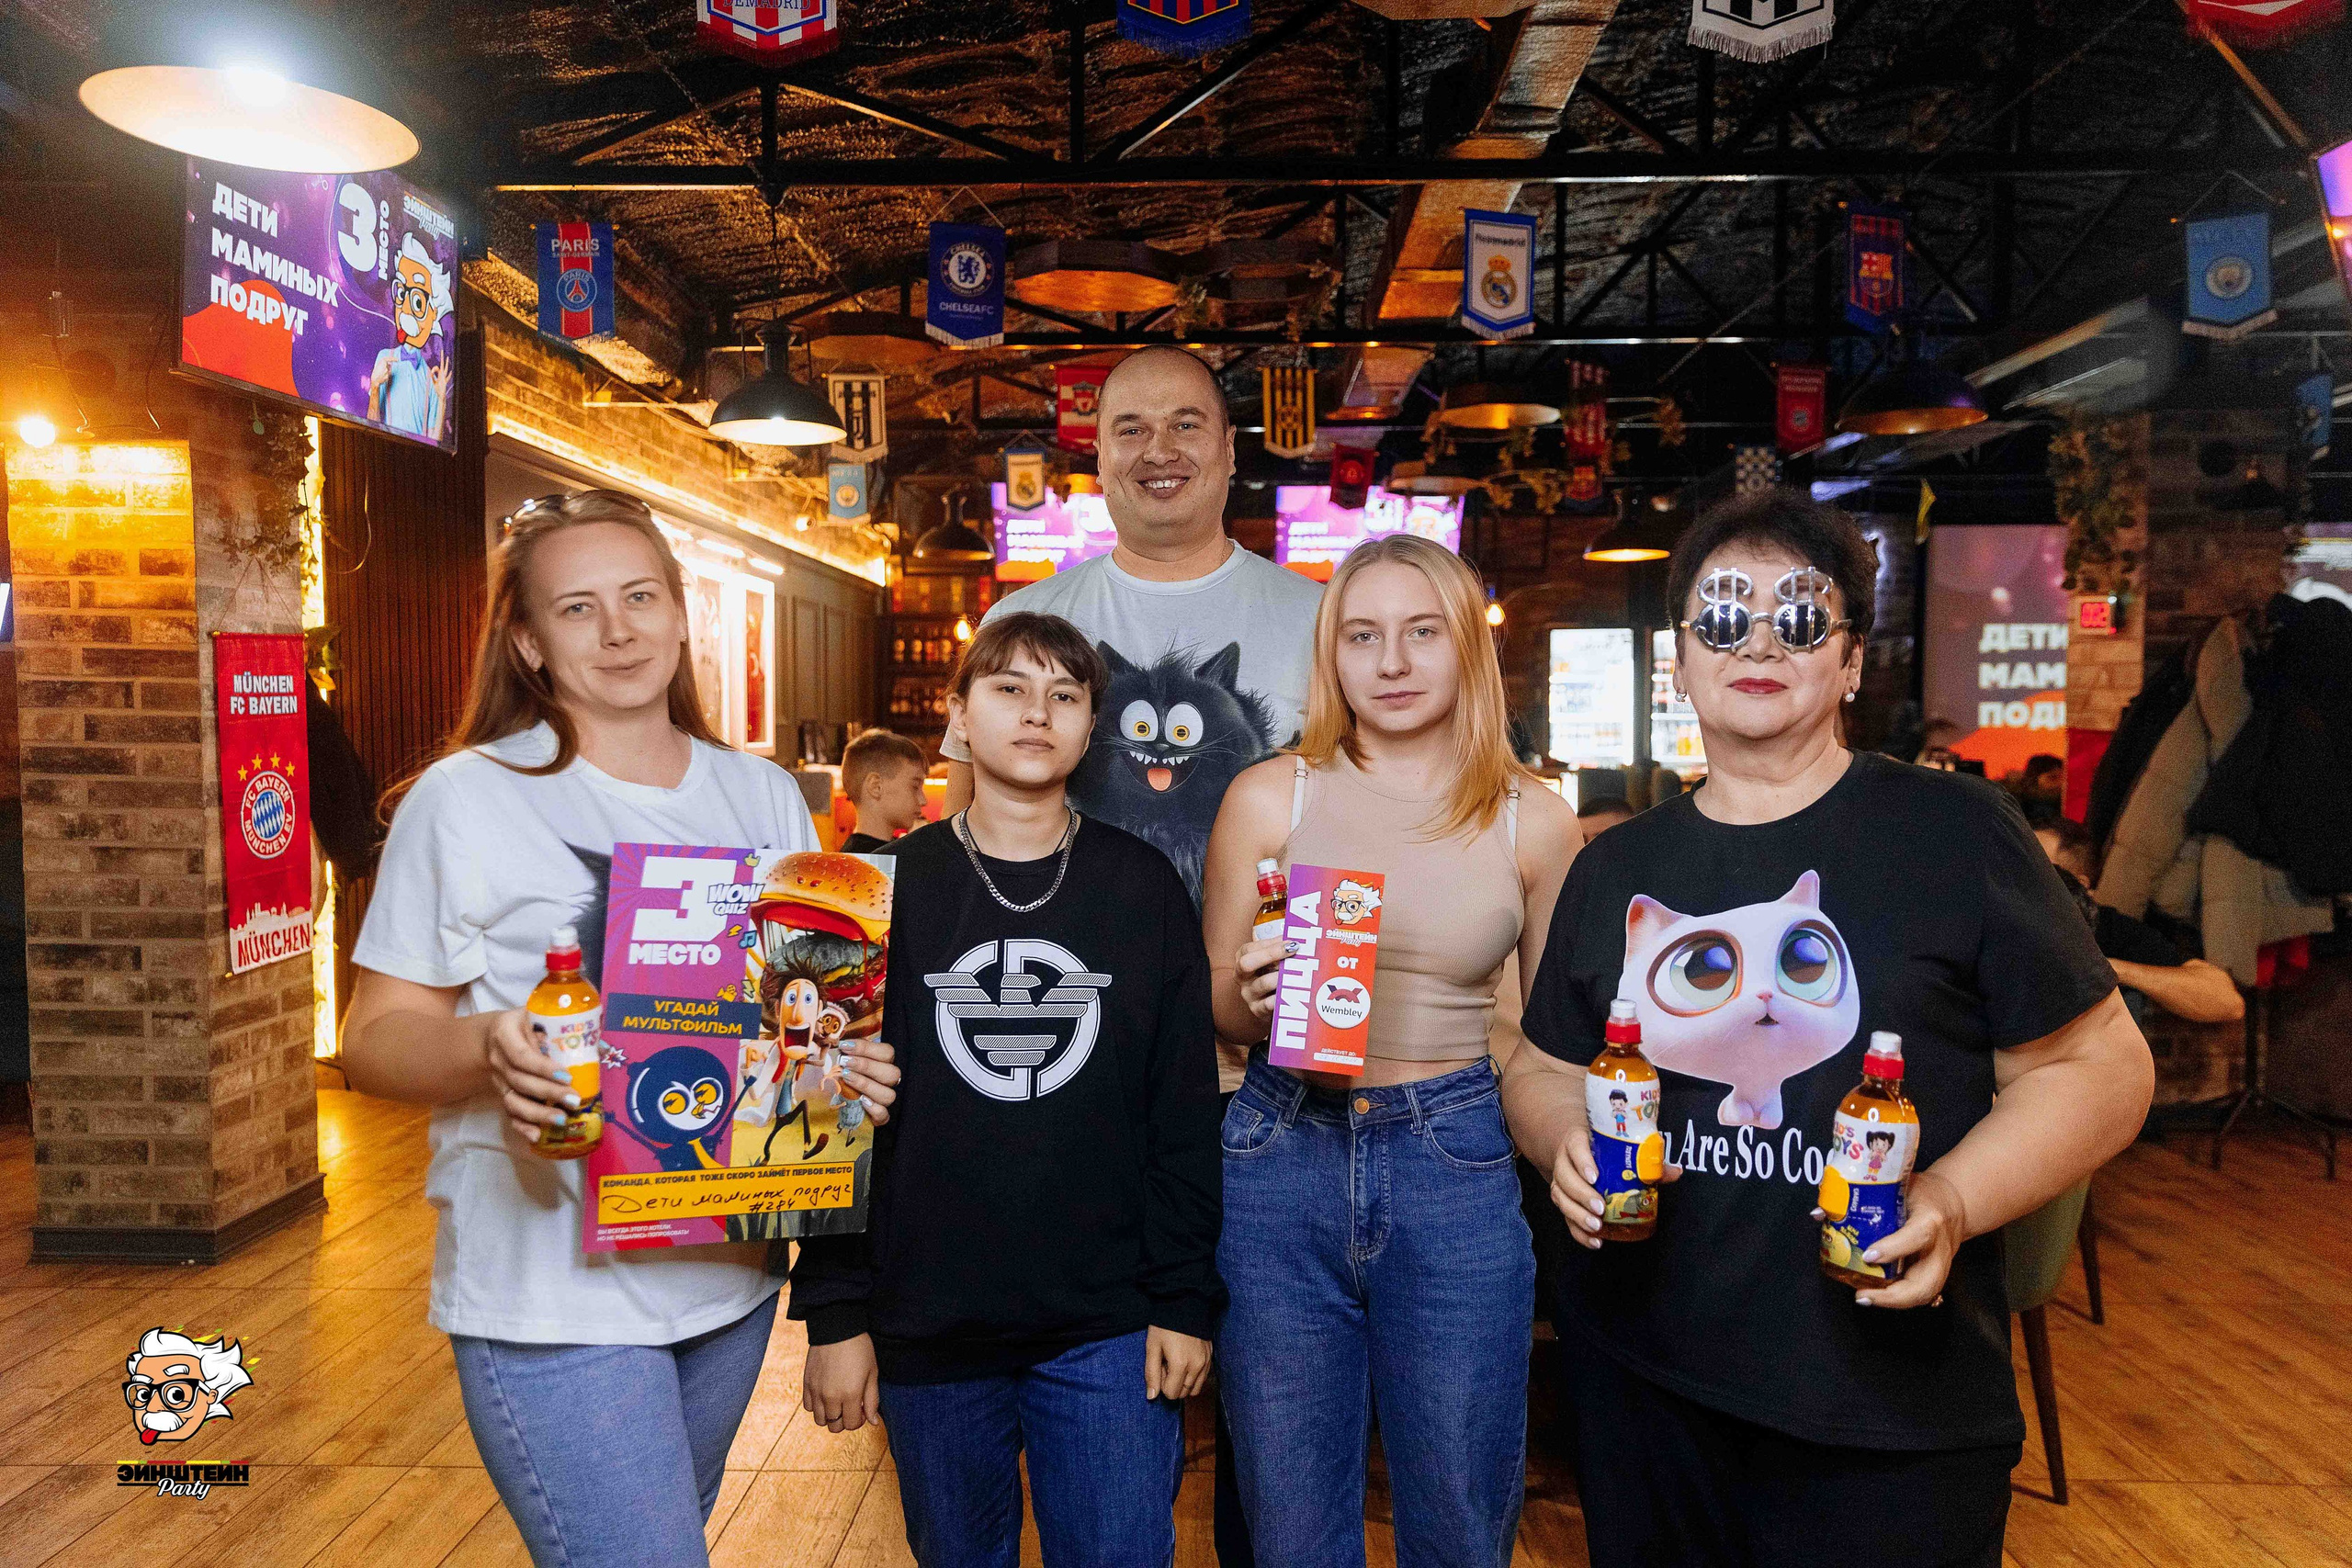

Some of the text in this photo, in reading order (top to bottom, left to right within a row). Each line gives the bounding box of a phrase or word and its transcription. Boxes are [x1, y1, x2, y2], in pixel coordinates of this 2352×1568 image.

[212, 182, 278, 238] ДЕТИ
[337, 182, 378, 272] 3
[378, 199, 390, 280] МЕСТО
[551, 238, 600, 253] PARIS
[211, 226, 339, 308] МАМИНЫХ
[210, 274, 309, 336] ПОДРУГ
[233, 671, 294, 694] MÜNCHEN
[231, 695, 298, 715] FC BAYERN
[245, 776, 290, 808] FC BAYERN
[284, 813, 292, 833] EV
[631, 855, 738, 942] 3
[707, 883, 765, 904] WOW
[713, 902, 749, 916] QUIZ
[237, 922, 311, 968] MÜNCHEN
[628, 942, 721, 965] МЕСТО
[1275, 890, 1322, 1050] ПИЦЦА
[1337, 956, 1358, 969] ОТ
[654, 1000, 719, 1016] УГАДАЙ
[1321, 1005, 1363, 1019] Wembley
[623, 1015, 742, 1035] МУЛЬТФИЛЬМ
[1677, 1119, 1729, 1176] Are
[1736, 1125, 1774, 1179] So
[603, 1166, 853, 1188] КОМАНДА, КОТОРАЯ ТОЖЕ СКОРО ЗАЙМЁТ ПЕРВОЕ МЕСТО
[602, 1183, 852, 1213] Дети маминых подруг
[615, 1232, 647, 1240] РЕШАЛИСЬ
